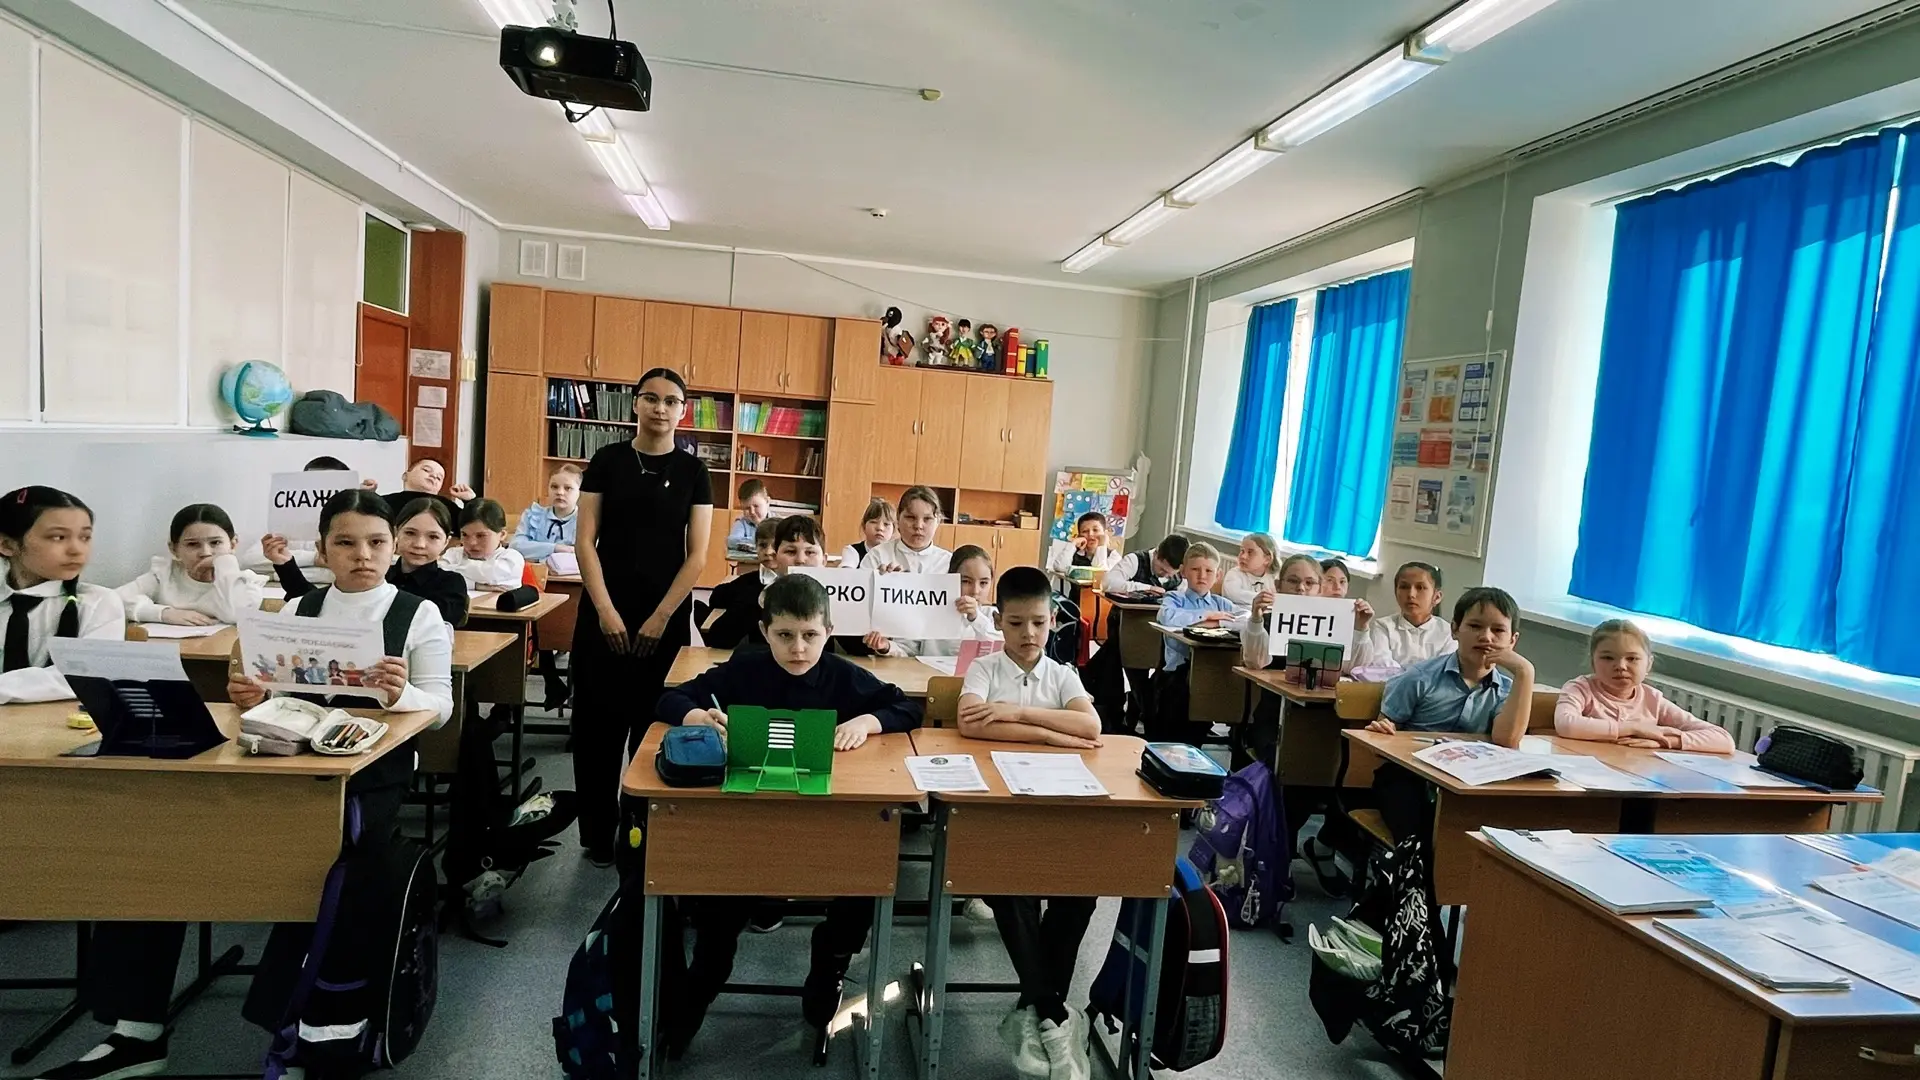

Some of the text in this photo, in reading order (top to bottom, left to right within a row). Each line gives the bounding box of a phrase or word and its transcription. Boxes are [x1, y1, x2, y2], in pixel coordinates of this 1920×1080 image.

[274, 489, 340, 508] СКАЖ
[826, 585, 866, 602] РКО
[880, 587, 948, 606] ТИКАМ
[1277, 612, 1335, 638] НЕТ!
